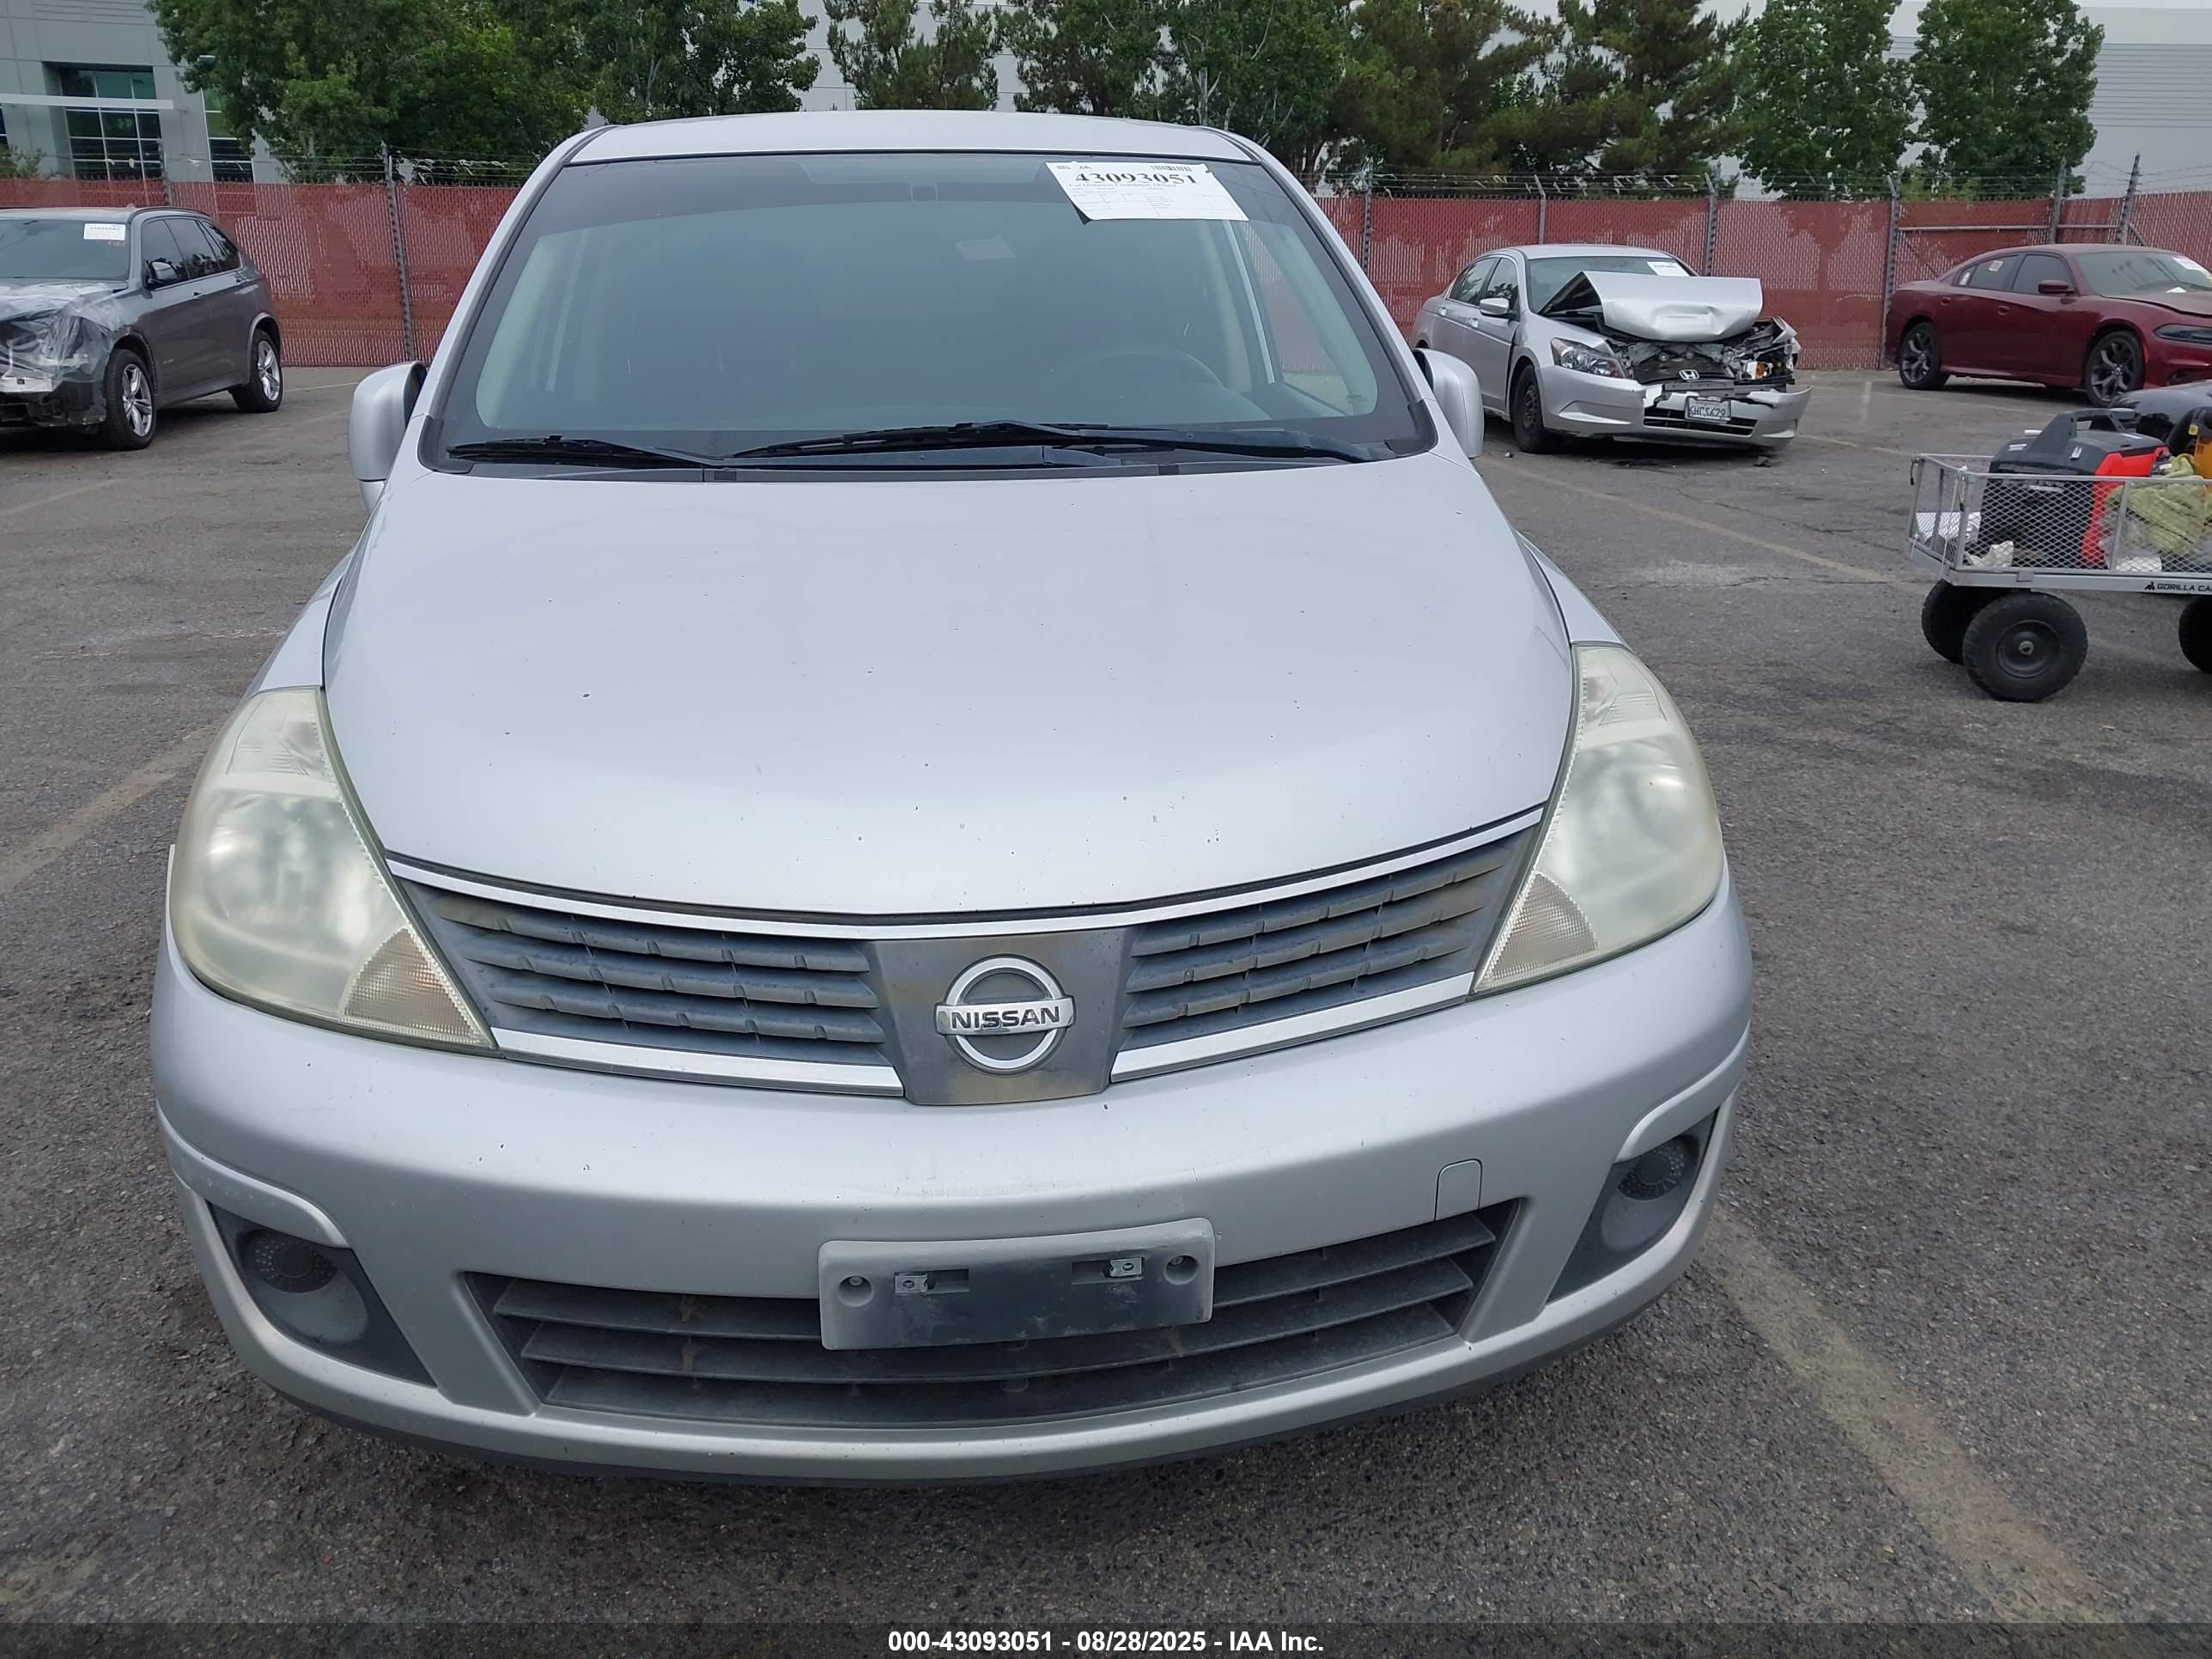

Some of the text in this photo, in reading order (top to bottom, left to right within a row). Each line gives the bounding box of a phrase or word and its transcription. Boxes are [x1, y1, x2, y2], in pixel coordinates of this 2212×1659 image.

[1075, 173, 1200, 185] 43093051
[2157, 583, 2195, 592] GORILLA
[951, 1006, 1060, 1030] NISSAN
